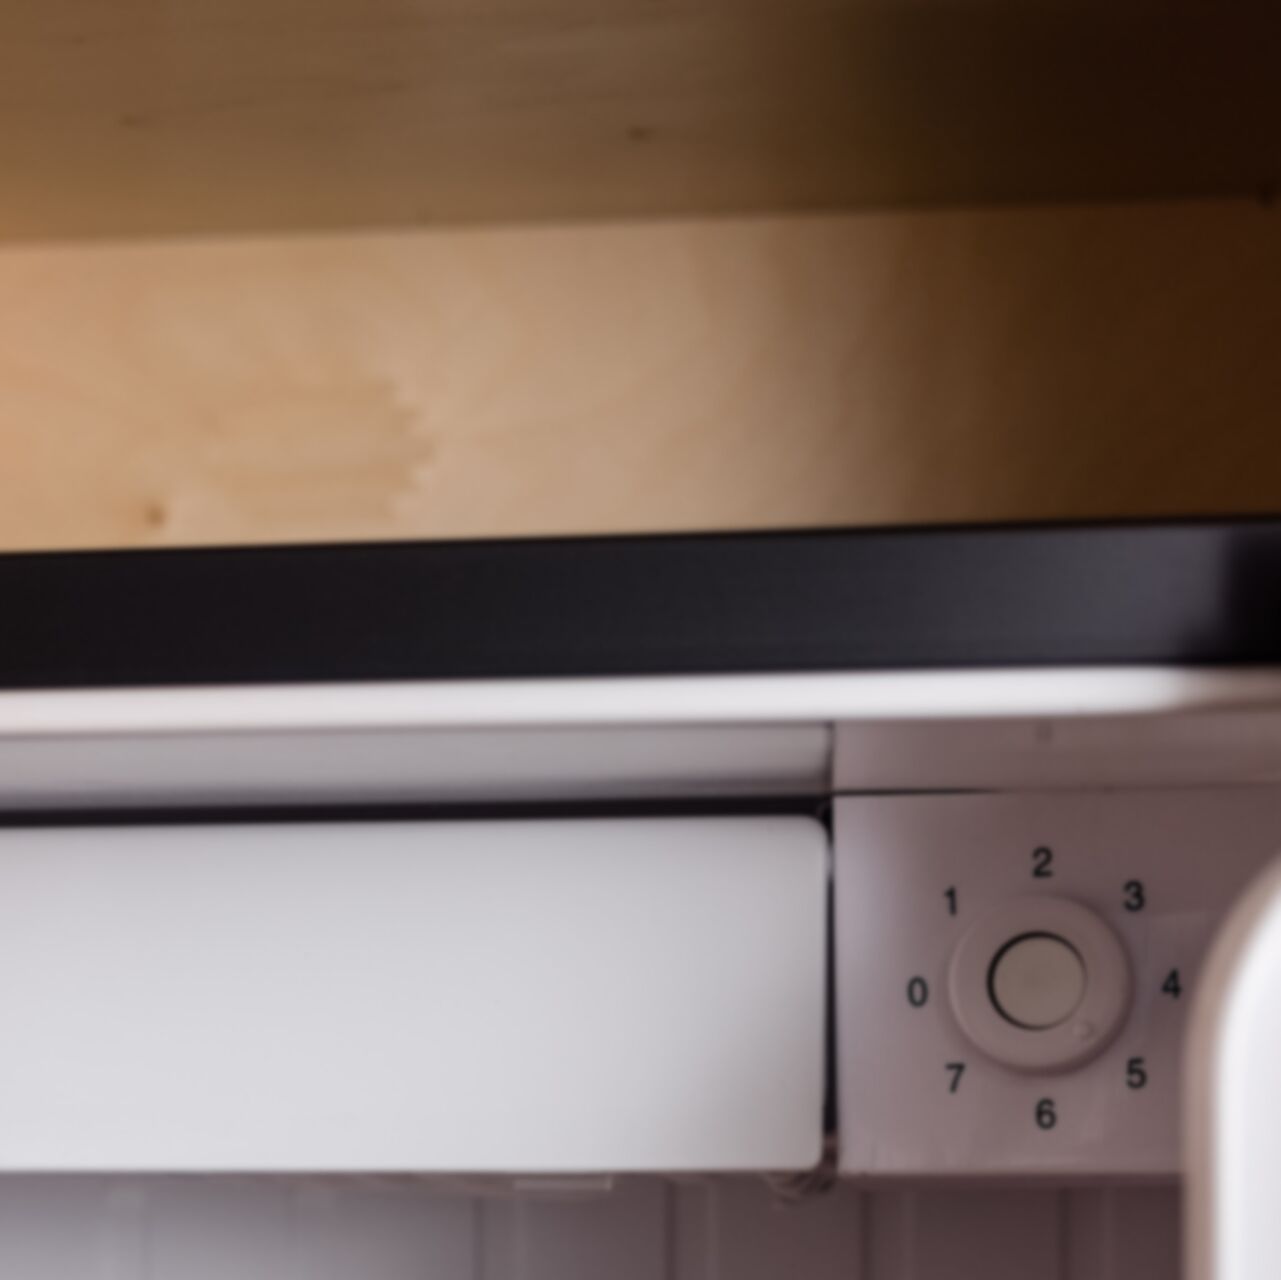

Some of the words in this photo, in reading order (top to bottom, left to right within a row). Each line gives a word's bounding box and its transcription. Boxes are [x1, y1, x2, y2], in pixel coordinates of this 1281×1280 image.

[1031, 846, 1054, 878] 2
[944, 886, 958, 916] 1
[1123, 880, 1146, 912] 3
[907, 976, 929, 1008] 0
[1161, 969, 1182, 998] 4
[945, 1062, 966, 1093] 7
[1126, 1057, 1148, 1089] 5
[1035, 1098, 1057, 1130] 6
